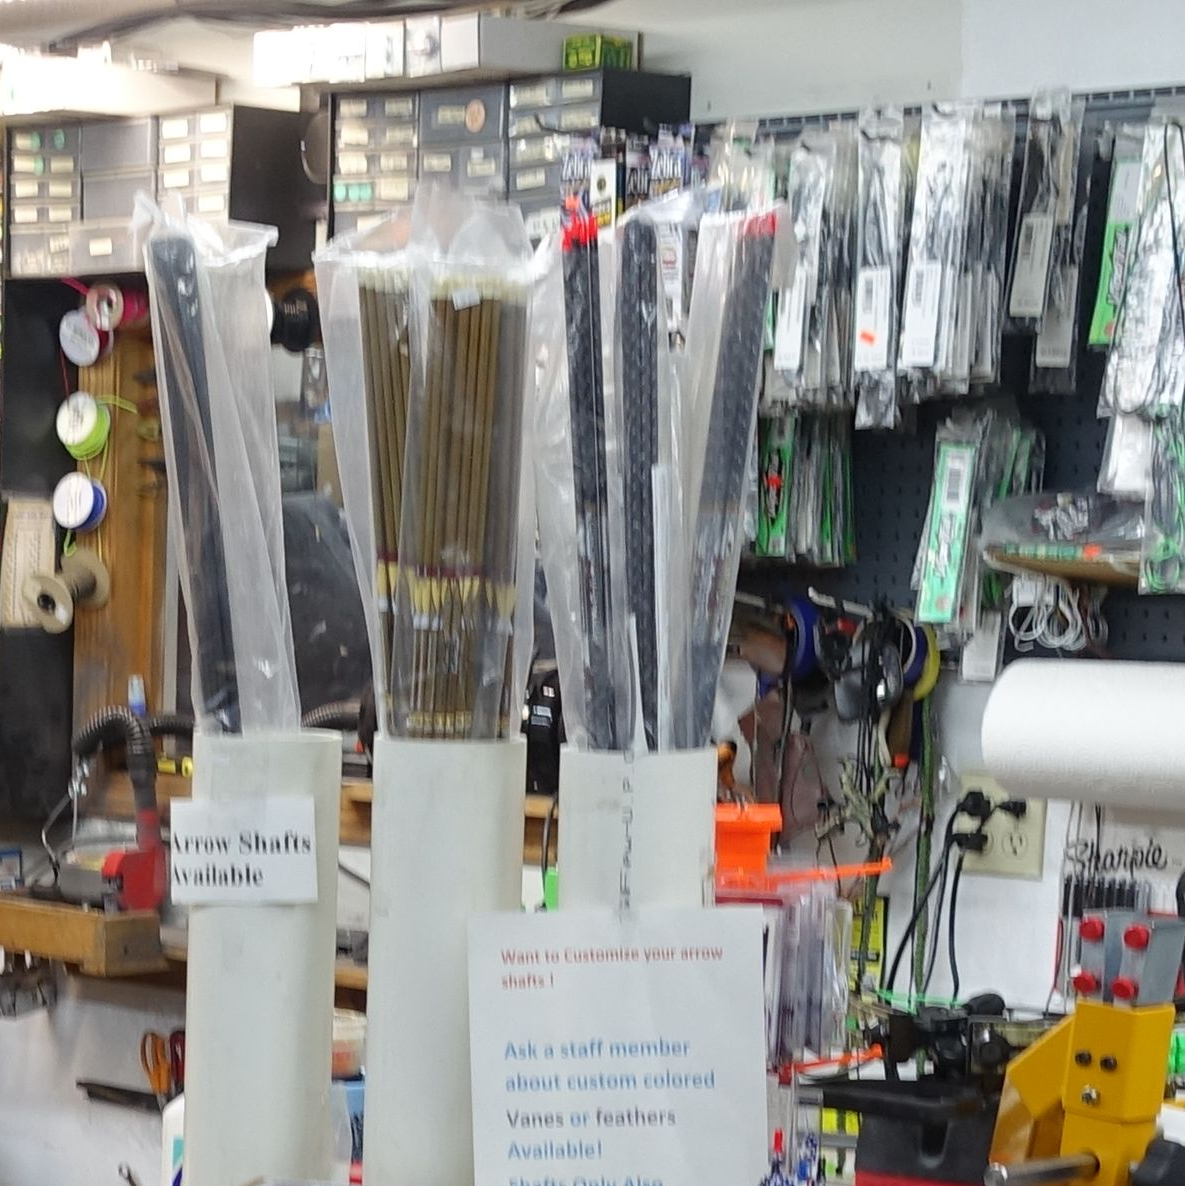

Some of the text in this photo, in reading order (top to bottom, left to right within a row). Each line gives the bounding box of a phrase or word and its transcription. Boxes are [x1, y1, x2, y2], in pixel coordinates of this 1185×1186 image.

[239, 829, 311, 855] Shafts
[1066, 838, 1168, 881] Sharpie
[501, 945, 723, 965] Want to Customize your arrow
[501, 972, 545, 989] shafts
[504, 1036, 690, 1060] Ask a staff member
[506, 1069, 715, 1092] about custom colored
[506, 1107, 676, 1129] Vanes or feathers
[508, 1140, 602, 1160] Available!
